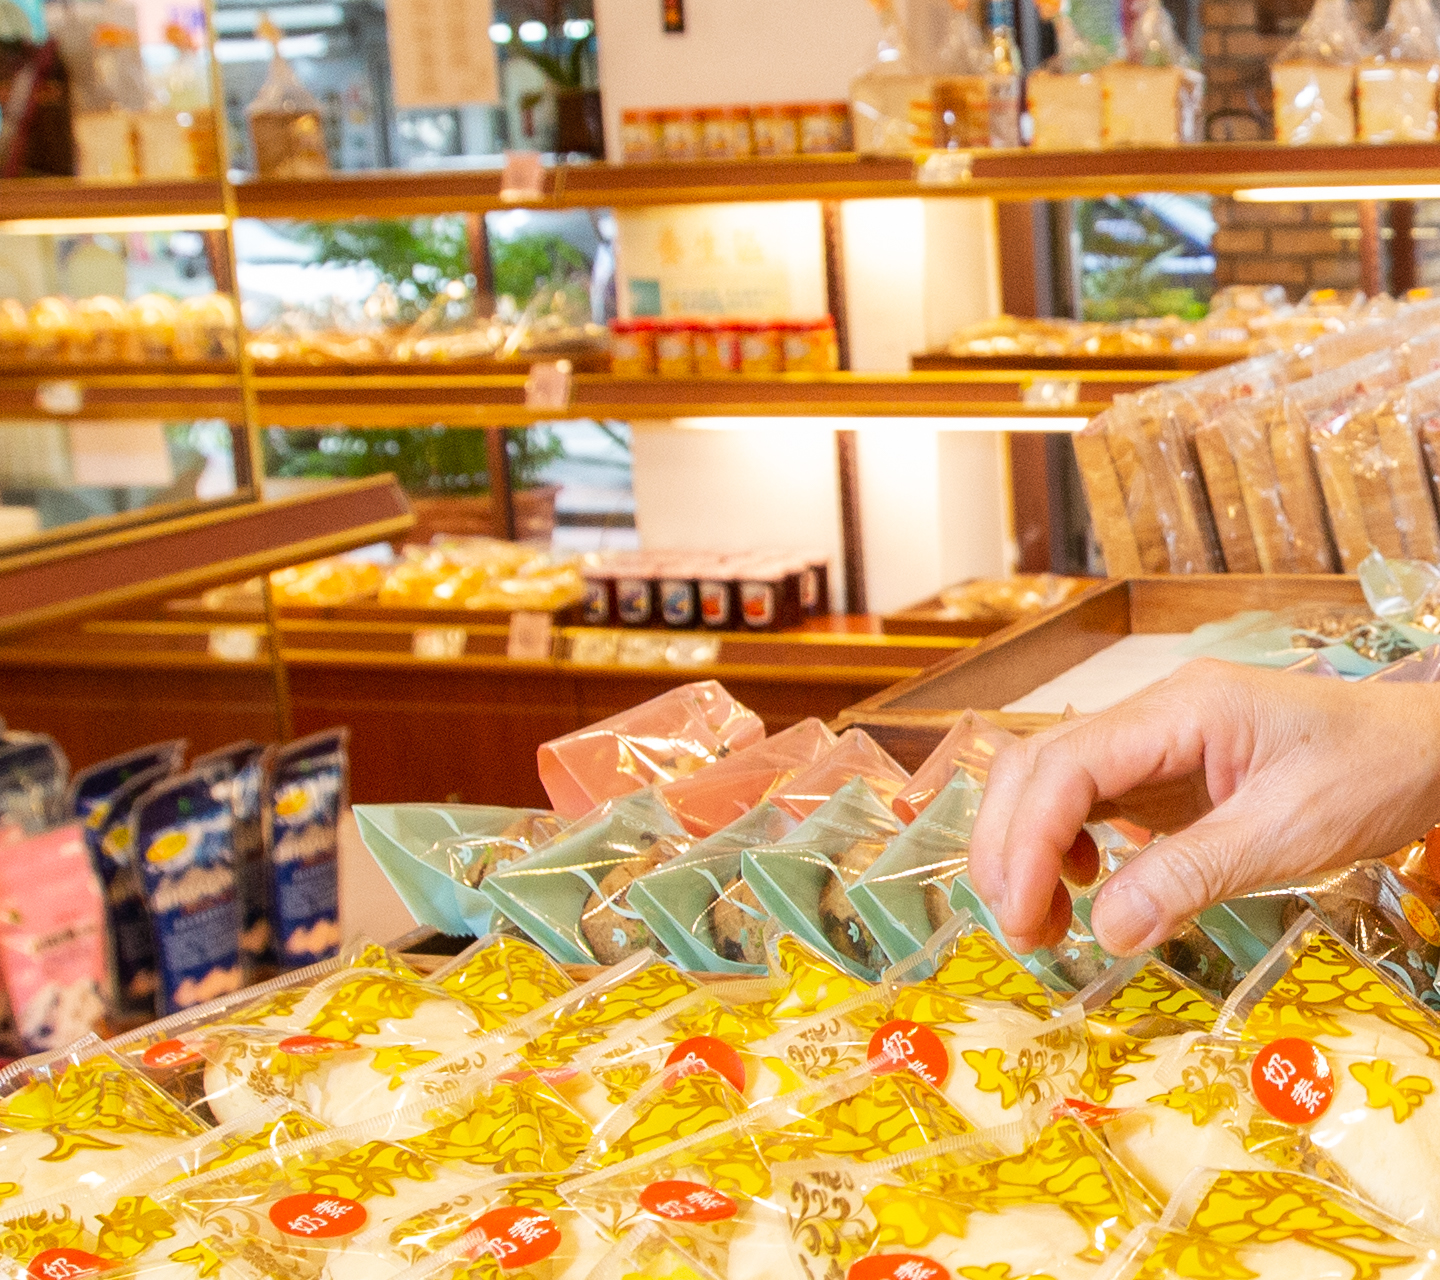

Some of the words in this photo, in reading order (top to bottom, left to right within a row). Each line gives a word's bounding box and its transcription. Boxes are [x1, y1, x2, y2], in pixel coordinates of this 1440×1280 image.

[1262, 1051, 1328, 1115] 奶素
[288, 1198, 353, 1236] 奶素
[655, 1190, 728, 1218] 奶素
